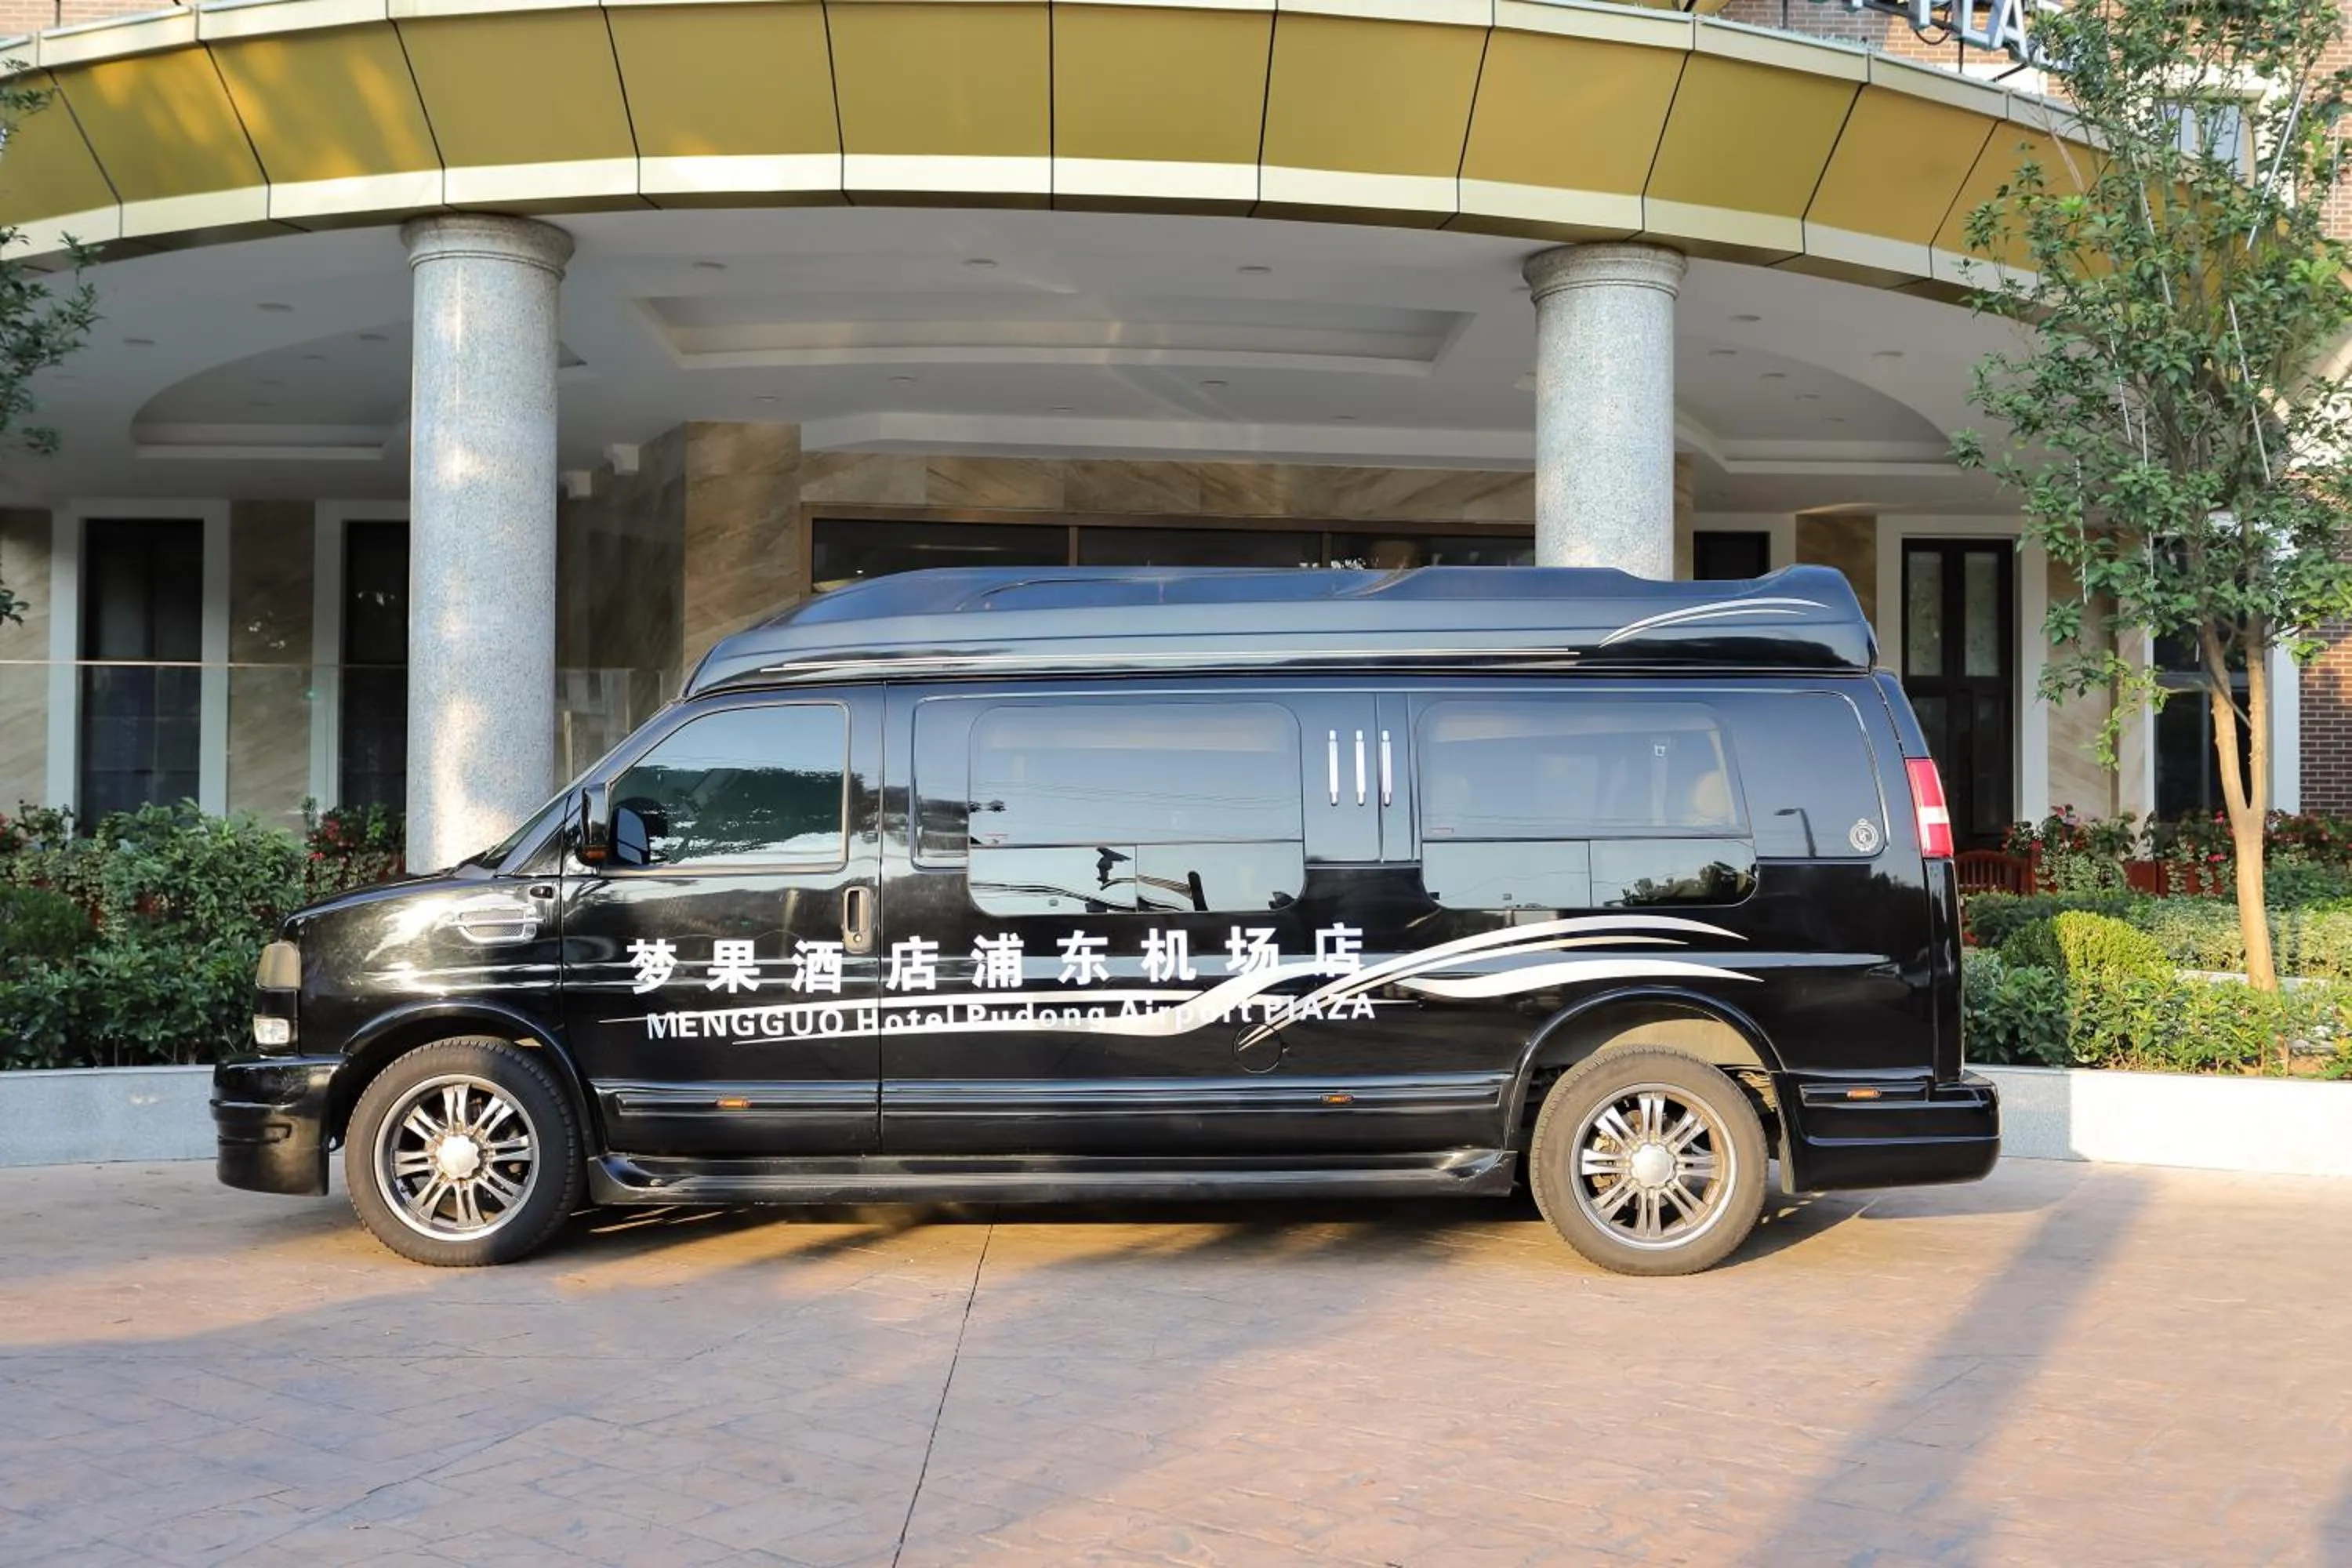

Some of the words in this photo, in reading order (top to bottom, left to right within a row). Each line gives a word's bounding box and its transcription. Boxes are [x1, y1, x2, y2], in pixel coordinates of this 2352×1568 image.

[626, 922, 1364, 996] 梦果酒店浦东机场店
[646, 1009, 844, 1039] MENGGUO
[857, 1004, 954, 1033] Hotel
[967, 1003, 1105, 1030] Pudong
